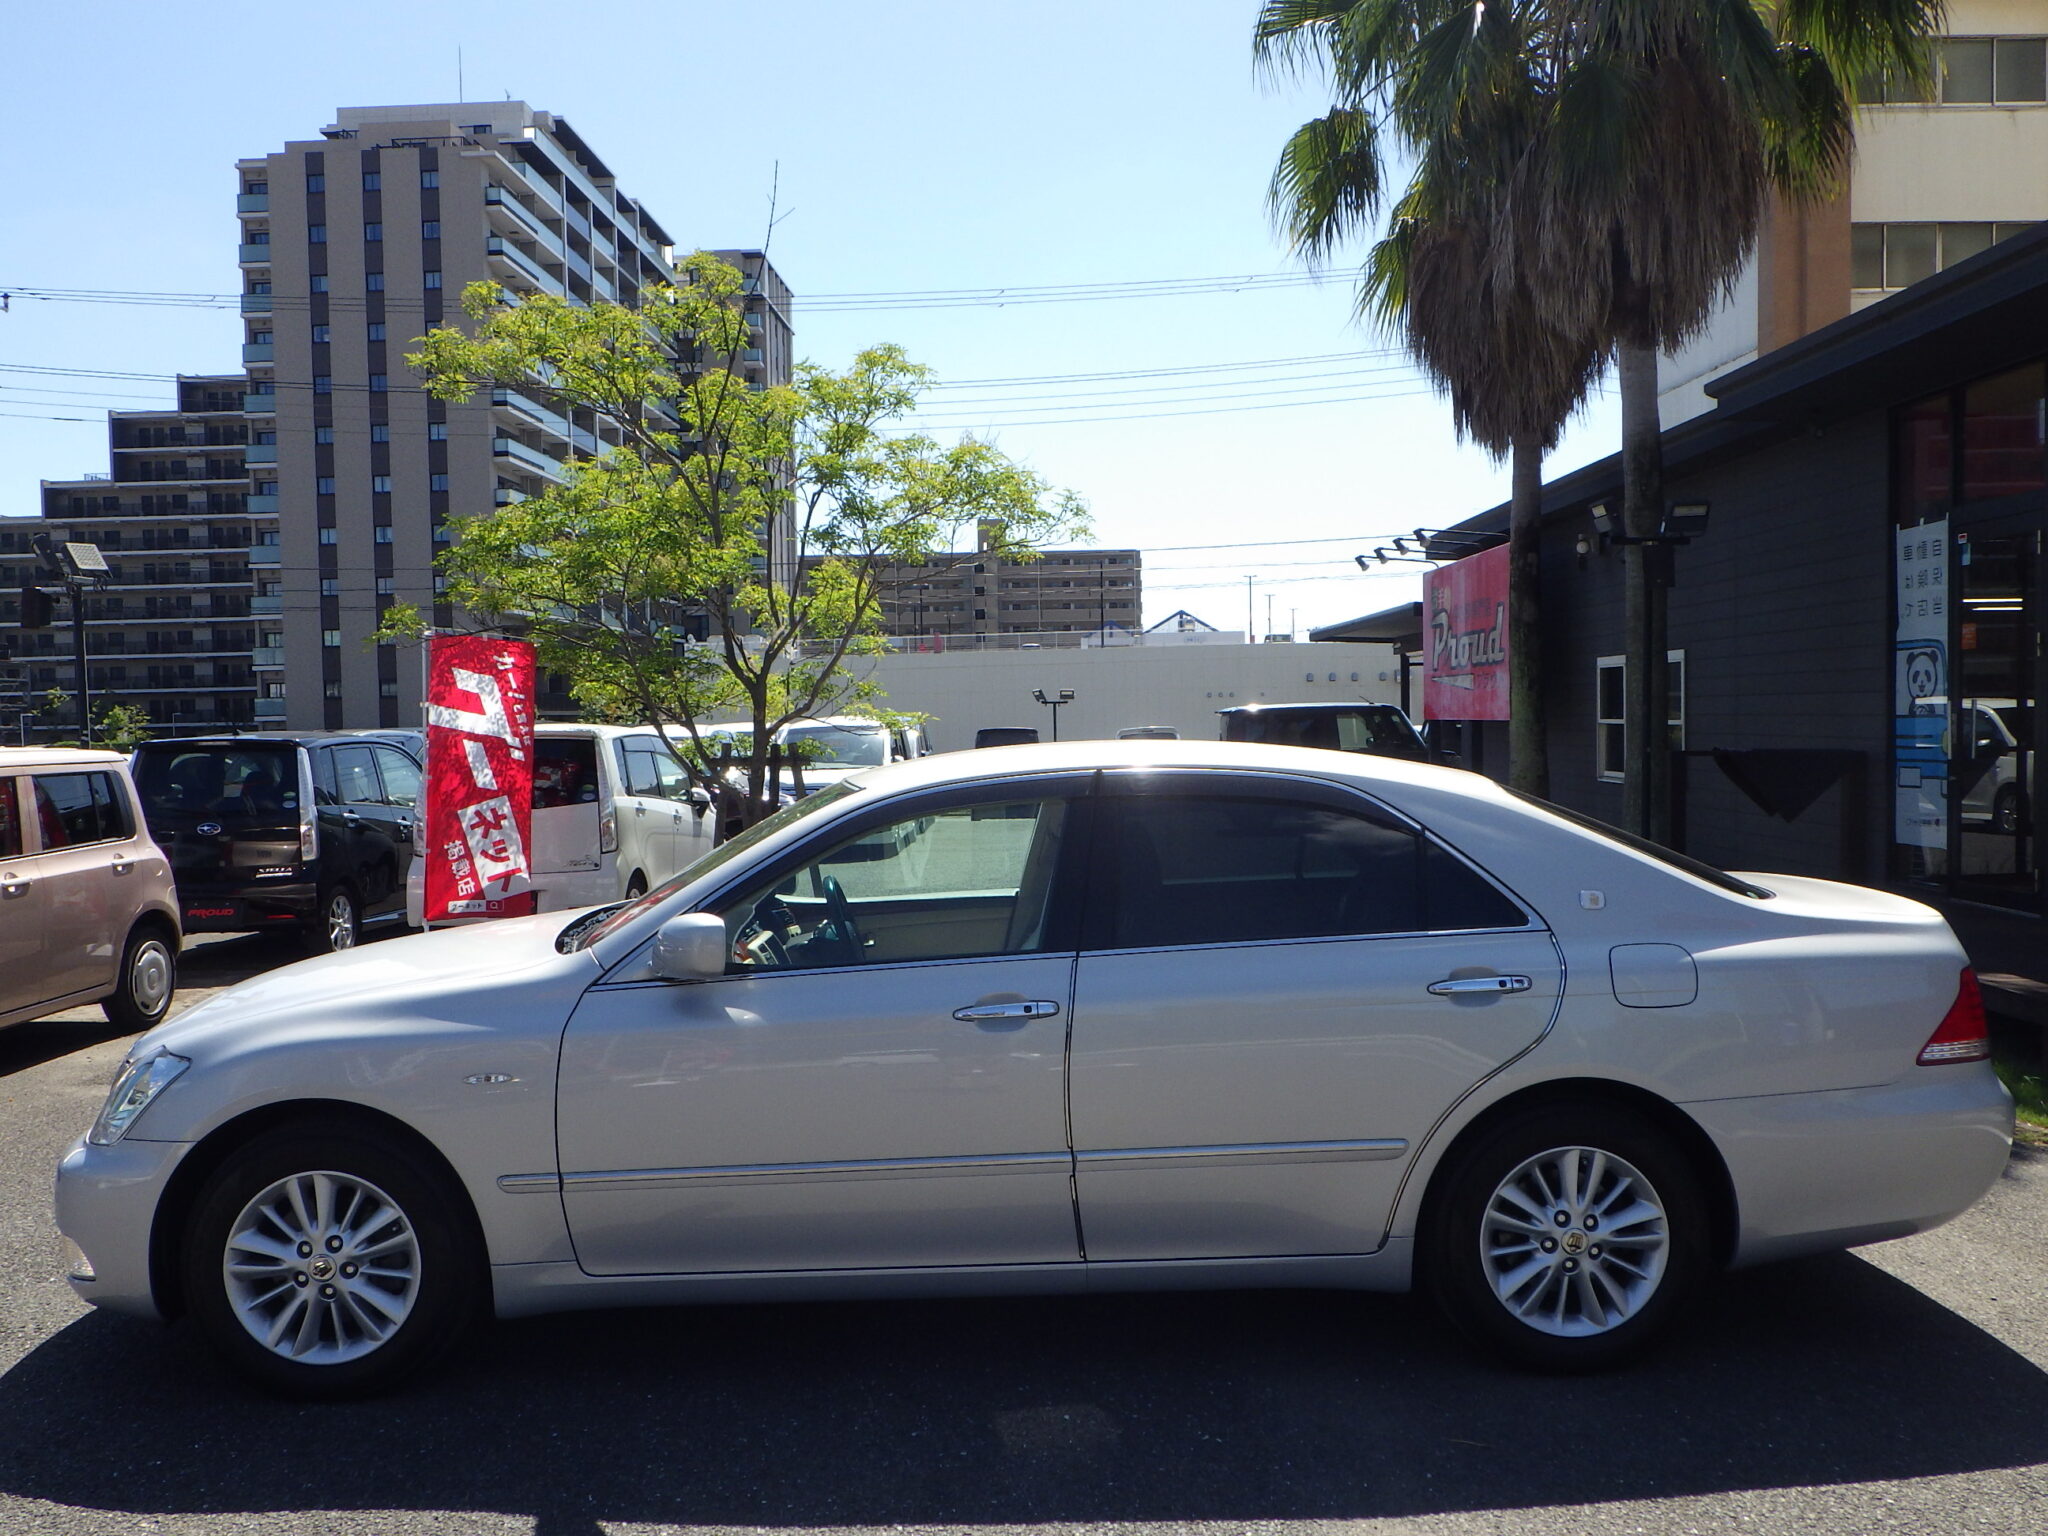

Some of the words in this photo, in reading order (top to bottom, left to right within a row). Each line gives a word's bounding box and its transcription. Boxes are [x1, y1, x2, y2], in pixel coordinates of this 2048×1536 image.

[1432, 601, 1505, 672] Proud
[444, 840, 475, 896] 掲載店
[187, 908, 236, 919] PROUD
